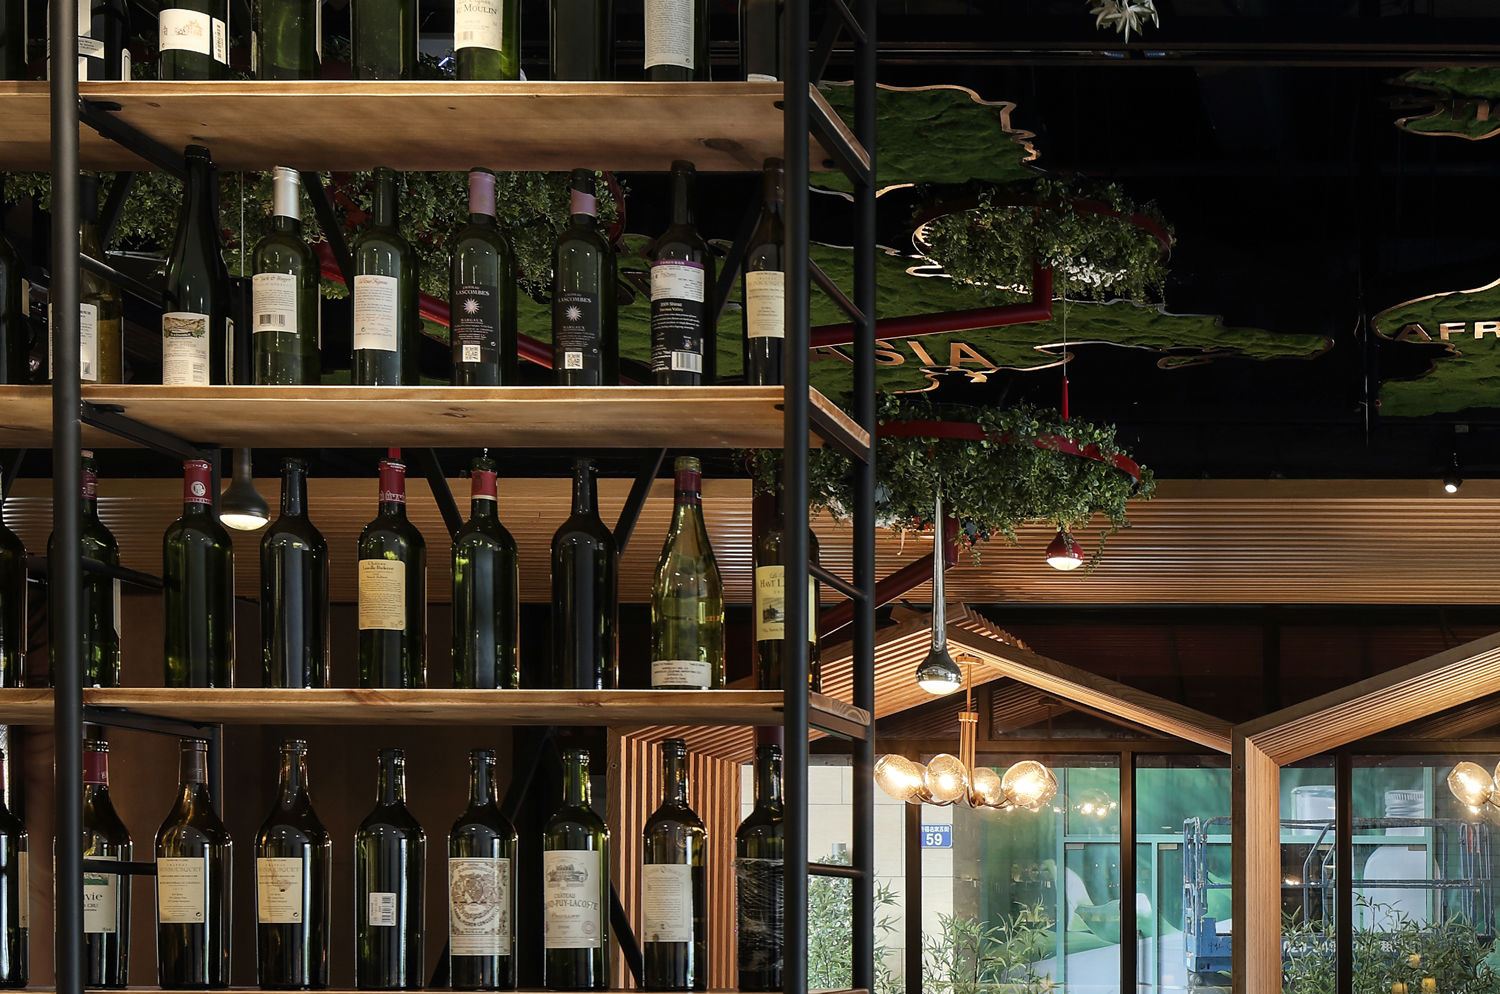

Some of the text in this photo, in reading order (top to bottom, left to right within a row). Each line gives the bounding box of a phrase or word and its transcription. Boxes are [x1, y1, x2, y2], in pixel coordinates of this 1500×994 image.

[456, 289, 490, 297] LASCOMBES
[558, 296, 592, 304] LASCOMBES
[926, 833, 943, 846] 59
